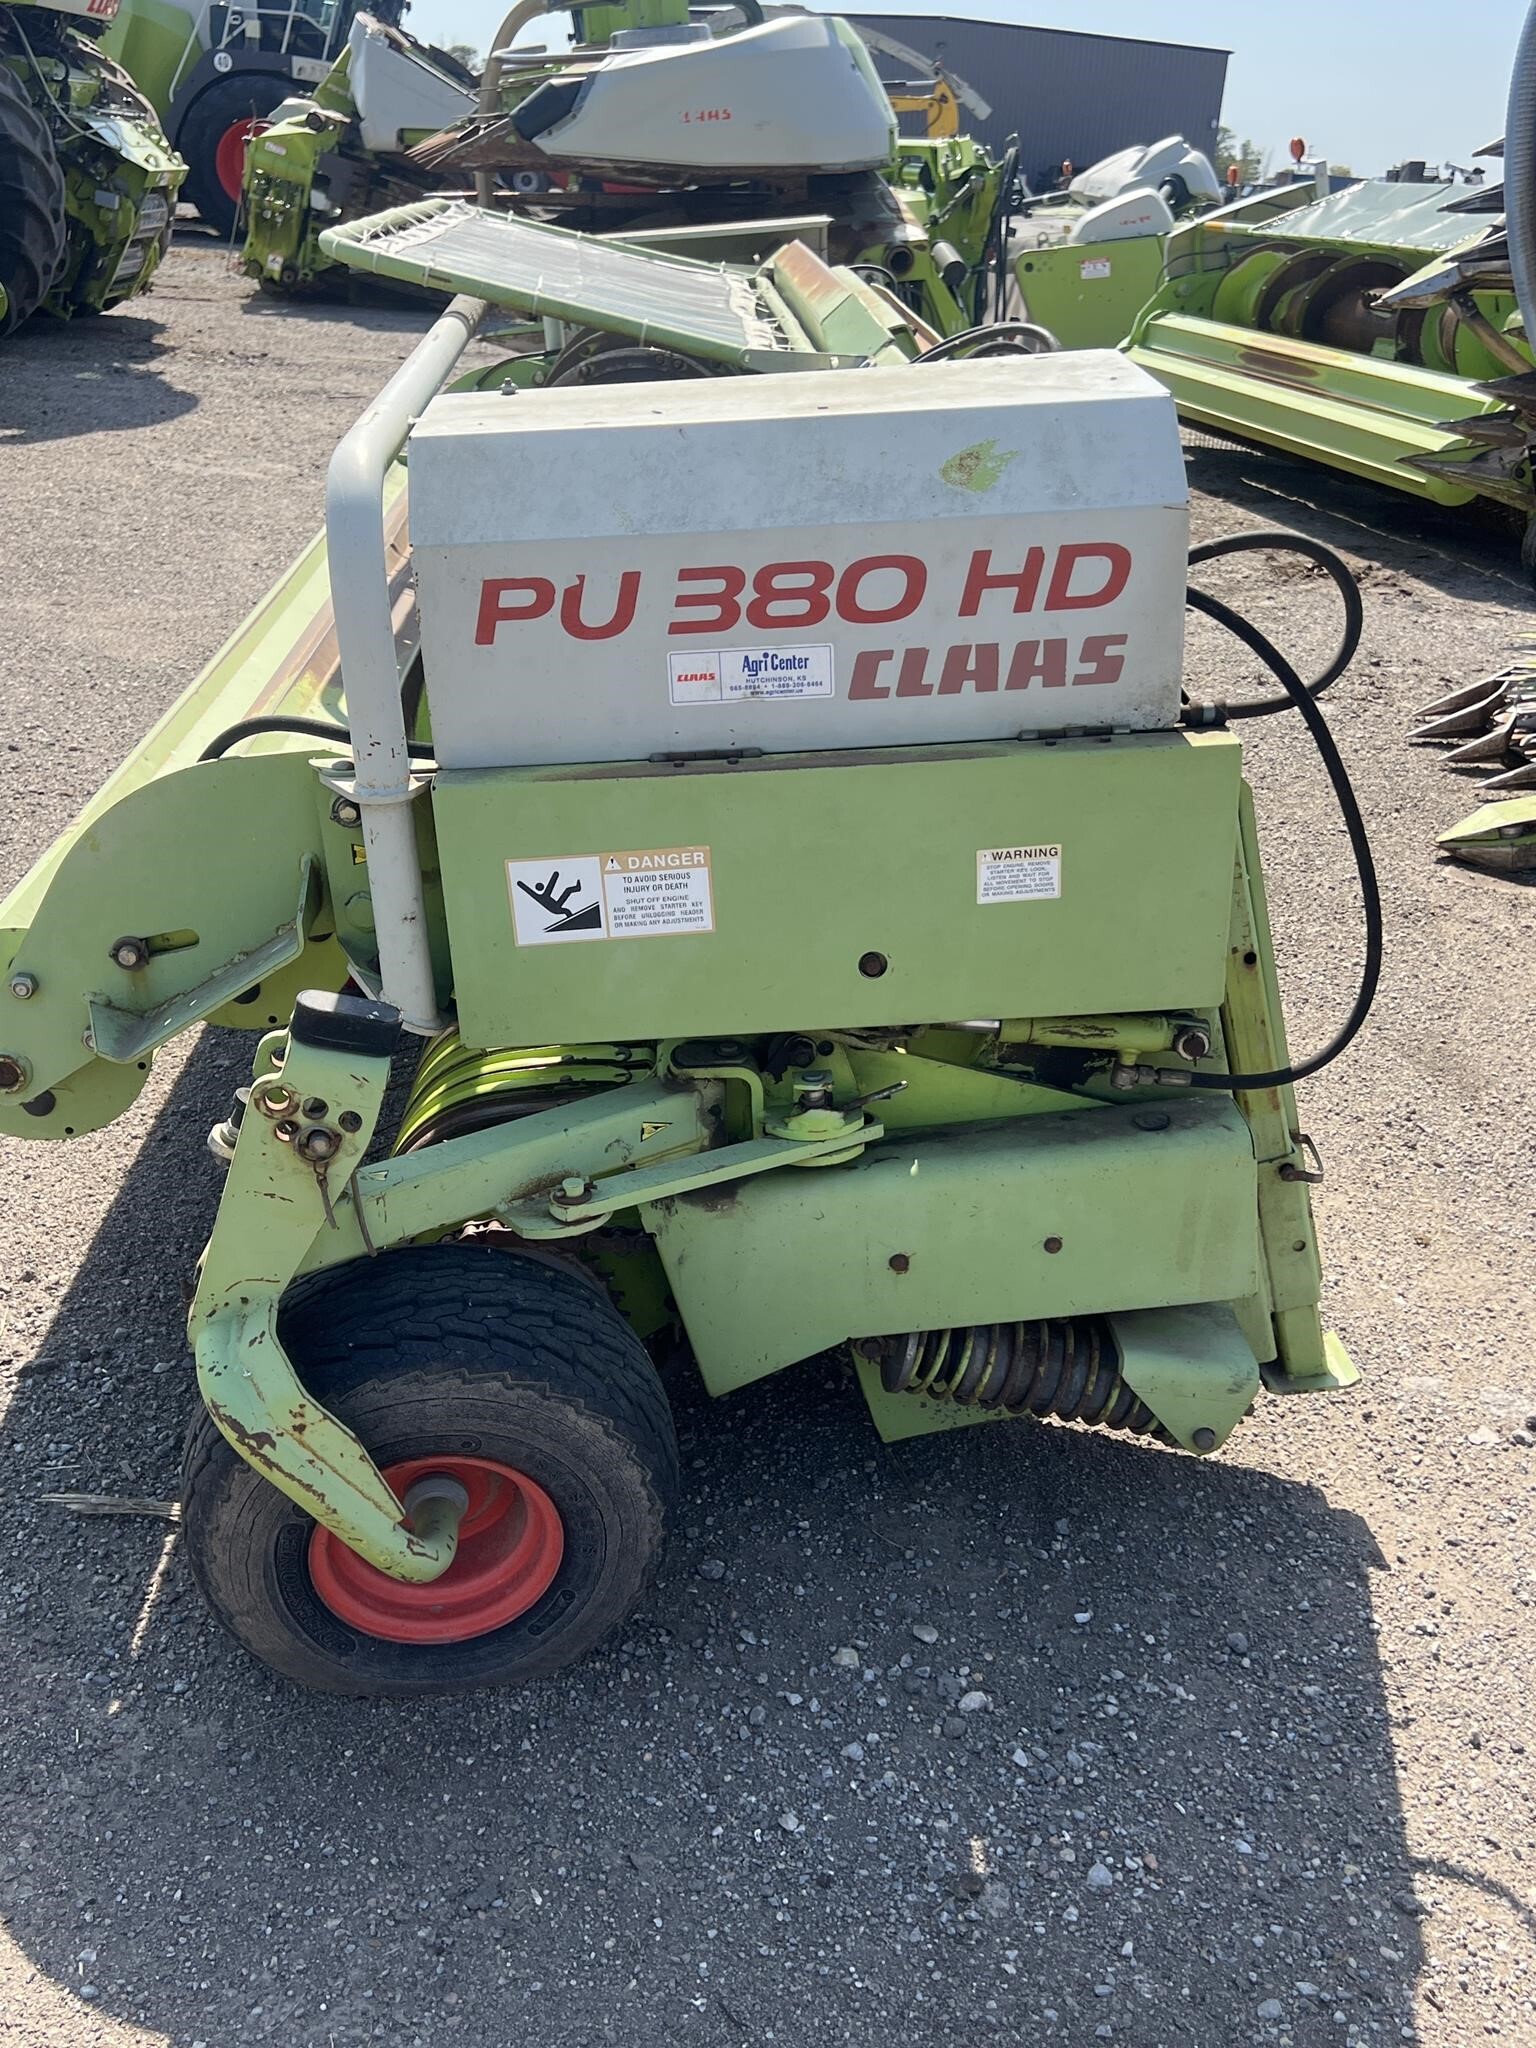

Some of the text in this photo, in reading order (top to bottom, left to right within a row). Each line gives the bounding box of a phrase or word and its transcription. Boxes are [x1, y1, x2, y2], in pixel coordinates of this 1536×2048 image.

[678, 108, 732, 124] LAAS
[475, 542, 1132, 645] PU 380 HD
[771, 654, 809, 670] Center
[848, 634, 1128, 700] CLAAS
[677, 672, 716, 682] CLAAS
[628, 852, 705, 869] DANGER
[992, 847, 1058, 861] WARNING
[635, 874, 656, 883] AVOID
[659, 872, 691, 881] SERIOUS
[624, 885, 649, 893] INJURY
[665, 882, 688, 890] DEATH
[662, 916, 704, 925] ADJUSTMENTS
